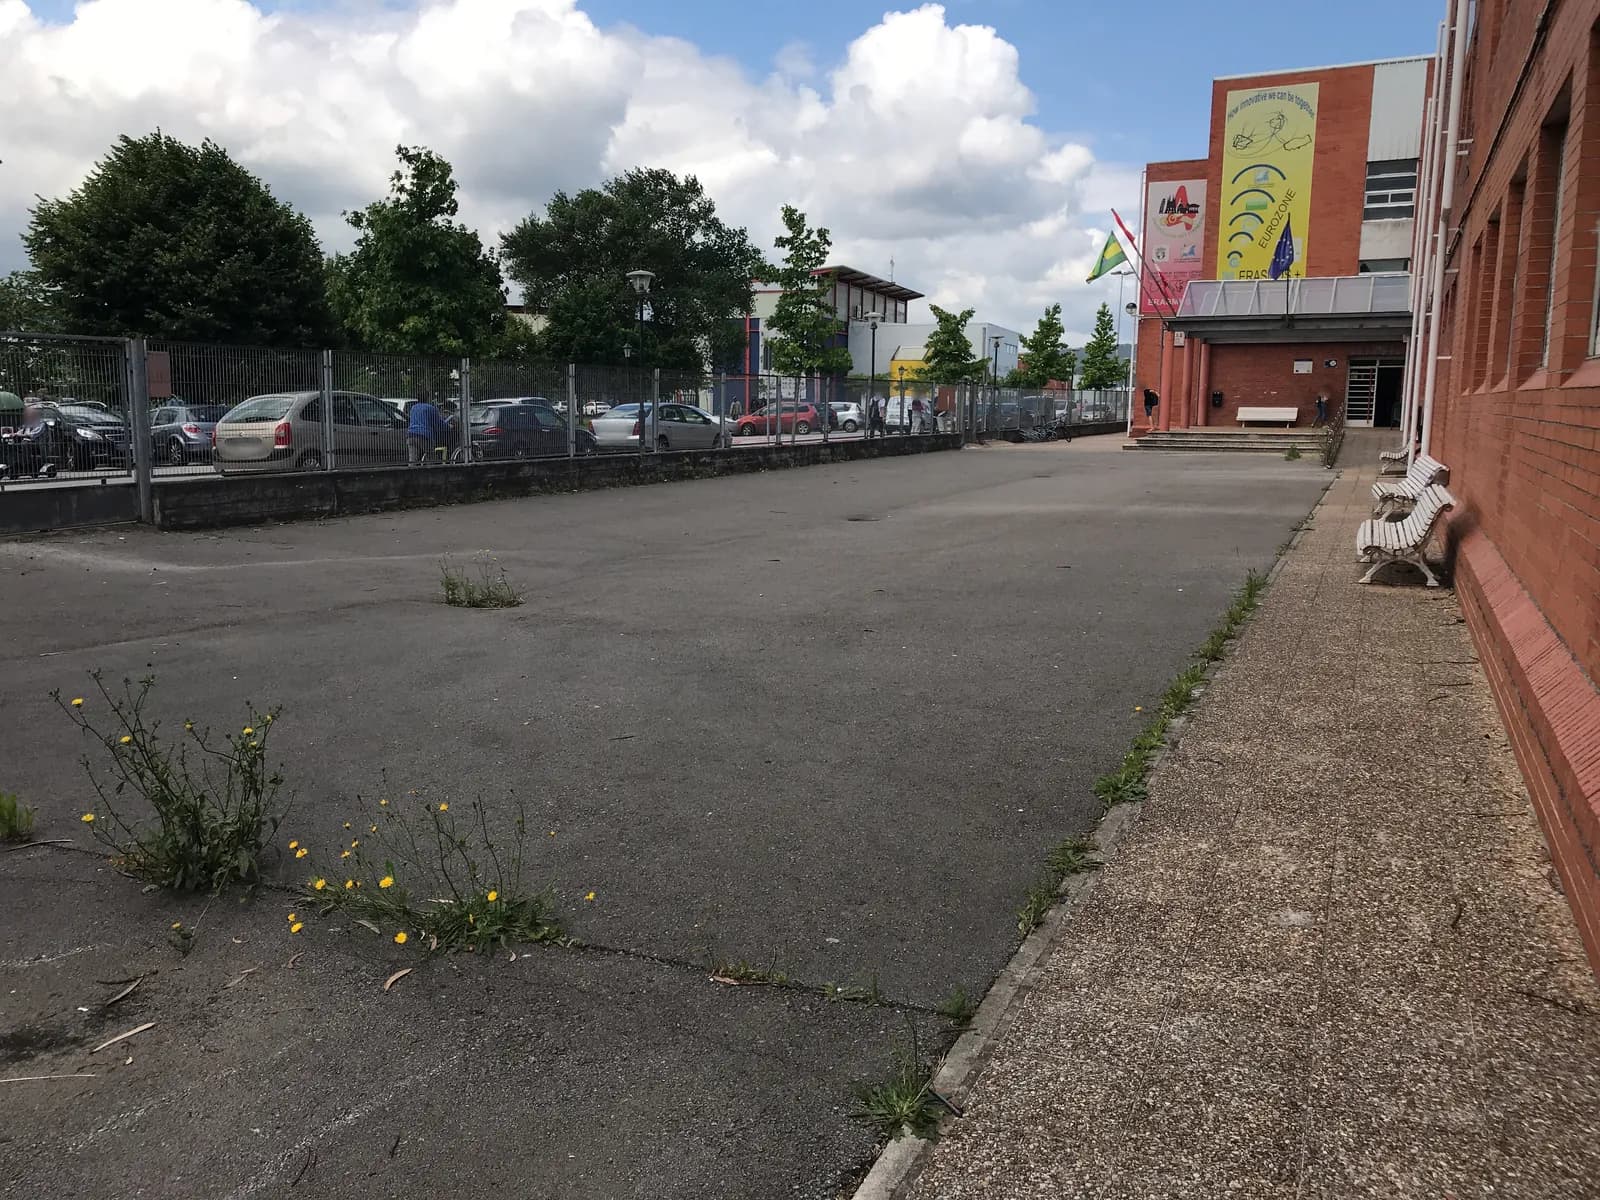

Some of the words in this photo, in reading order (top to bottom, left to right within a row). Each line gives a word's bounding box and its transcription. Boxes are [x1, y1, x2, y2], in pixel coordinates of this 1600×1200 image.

[1239, 92, 1267, 110] innovative
[1268, 91, 1276, 100] we
[1277, 91, 1287, 100] can
[1287, 91, 1294, 102] be
[1294, 95, 1315, 119] together
[1258, 188, 1297, 249] EUROZONE
